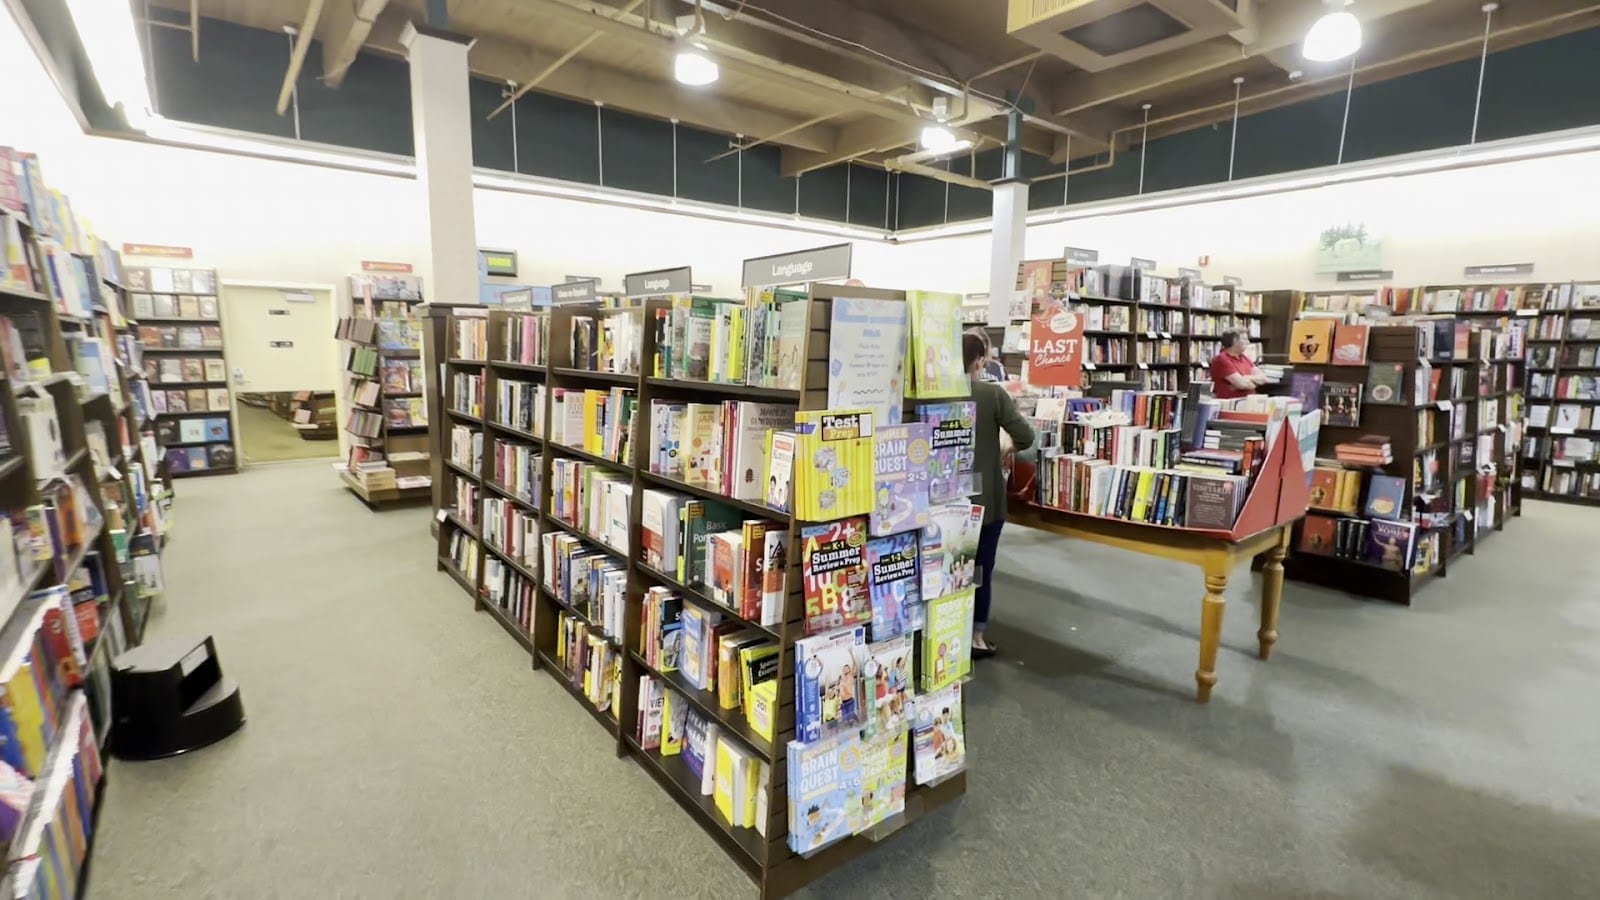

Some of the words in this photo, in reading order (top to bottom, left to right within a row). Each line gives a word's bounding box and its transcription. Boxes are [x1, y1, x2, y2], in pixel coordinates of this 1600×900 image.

[771, 261, 813, 277] Language
[1033, 339, 1078, 354] LAST
[1034, 352, 1072, 368] Chance
[823, 415, 859, 429] Test
[829, 429, 854, 439] Prep
[933, 429, 971, 440] Summer
[706, 521, 727, 531] Basic
[811, 546, 861, 565] Summer
[812, 561, 839, 573] Review
[844, 557, 861, 566] Prep
[873, 559, 914, 576] Summer
[874, 572, 898, 584] Review
[801, 749, 838, 778] BRAIN
[801, 767, 838, 794] QUEST
